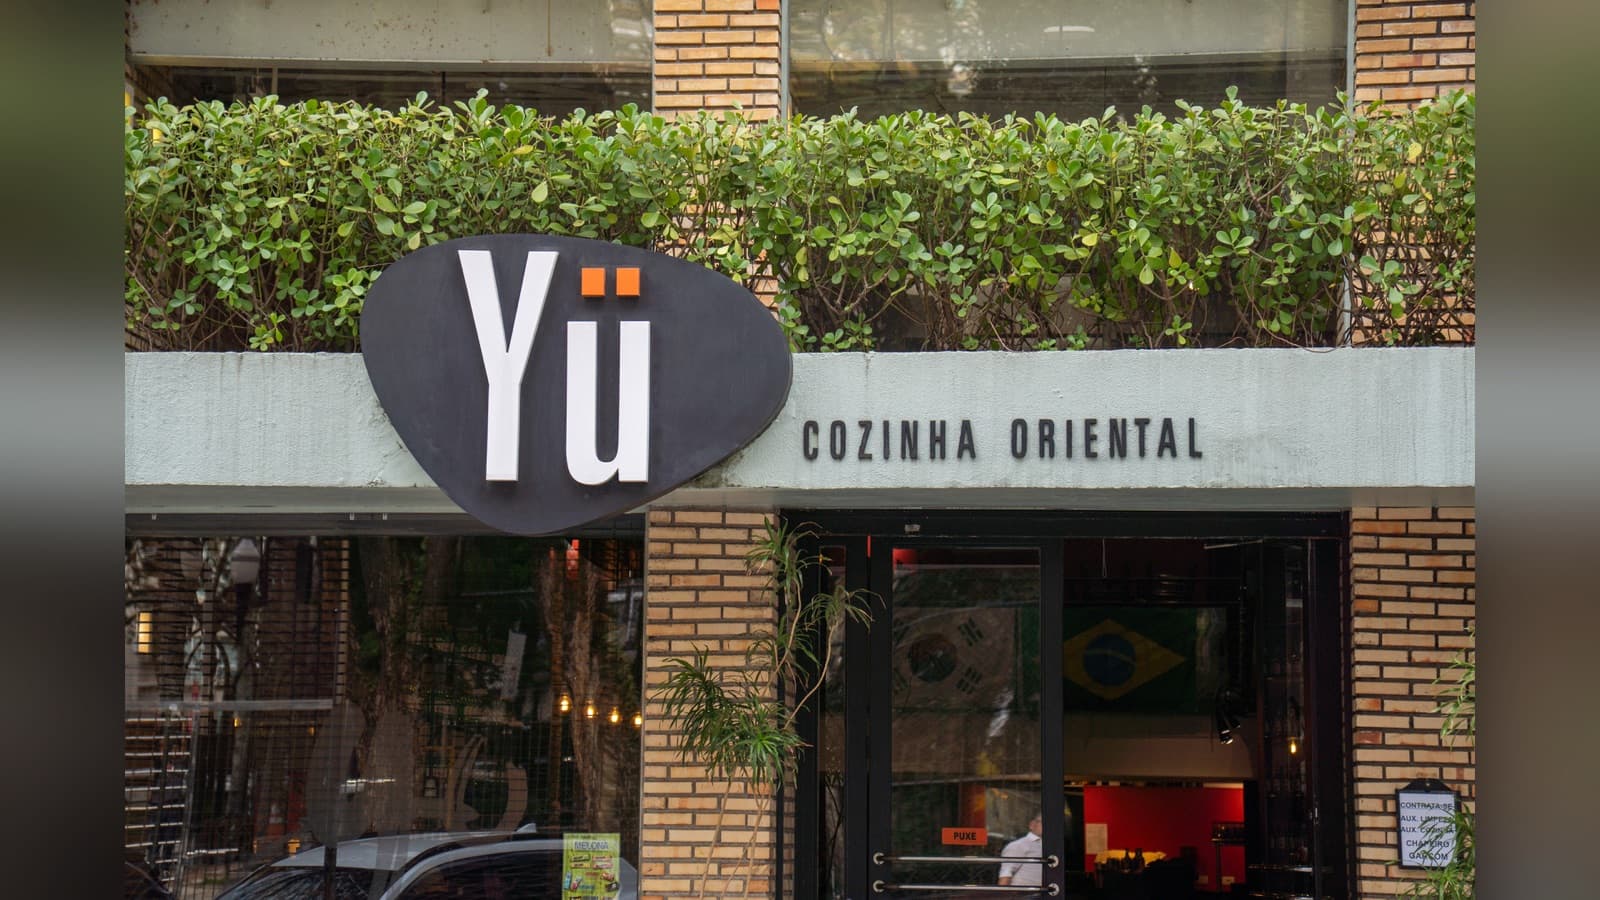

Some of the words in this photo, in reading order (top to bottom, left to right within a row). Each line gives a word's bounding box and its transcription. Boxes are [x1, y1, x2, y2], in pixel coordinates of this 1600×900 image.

[458, 250, 650, 485] Yü
[803, 420, 976, 461] COZINHA
[1011, 417, 1202, 459] ORIENTAL
[574, 841, 609, 850] MELONA
[953, 832, 977, 841] PUXE
